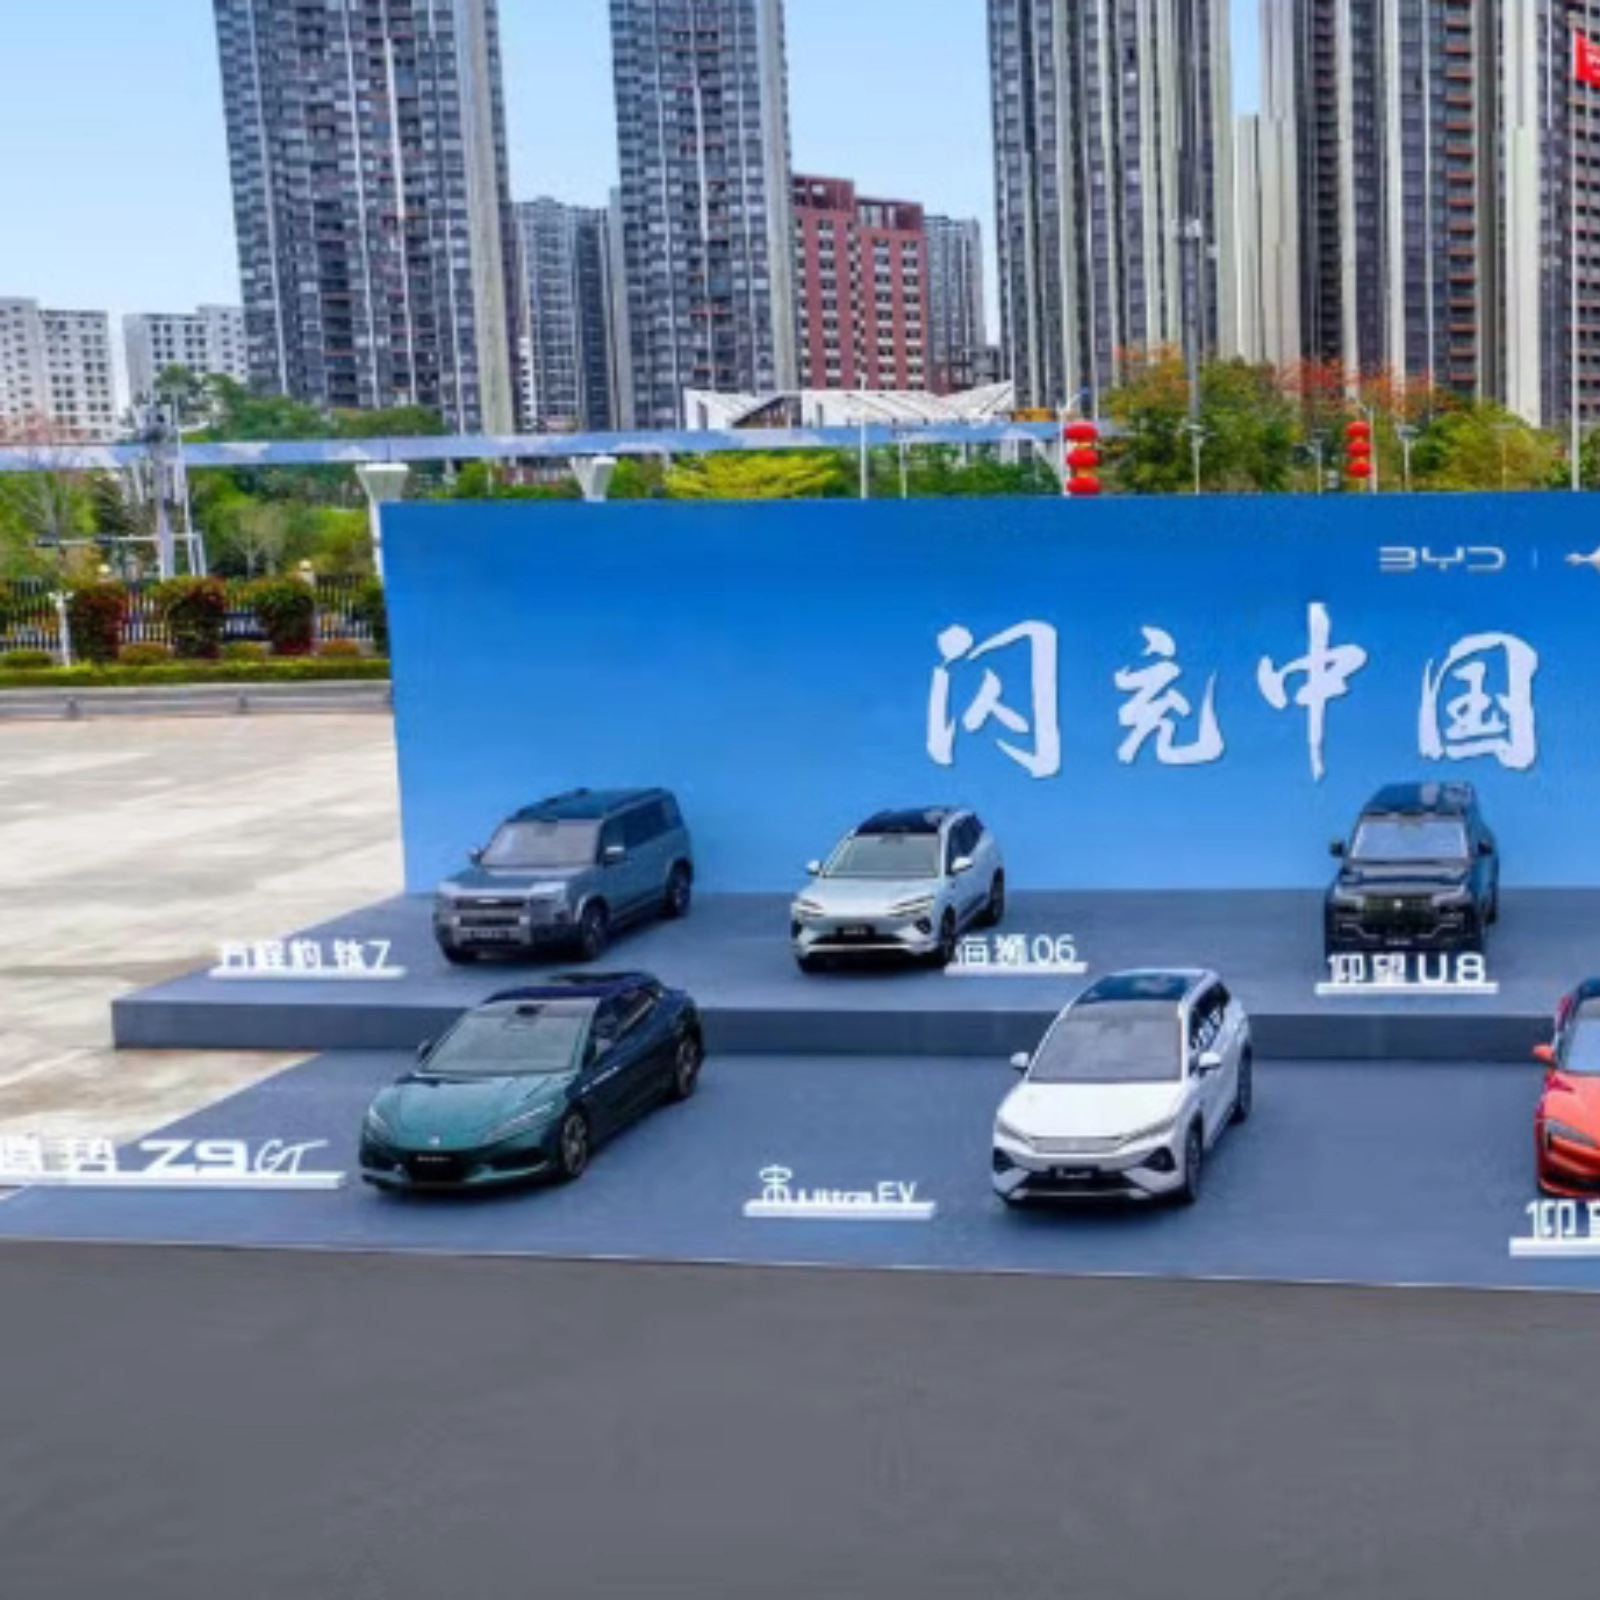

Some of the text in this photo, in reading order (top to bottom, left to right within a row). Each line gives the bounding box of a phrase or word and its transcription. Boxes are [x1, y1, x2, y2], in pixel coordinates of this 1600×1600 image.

[1379, 546, 1506, 572] BYD
[926, 602, 1538, 781] 闪充中国
[1418, 953, 1487, 984] U8
